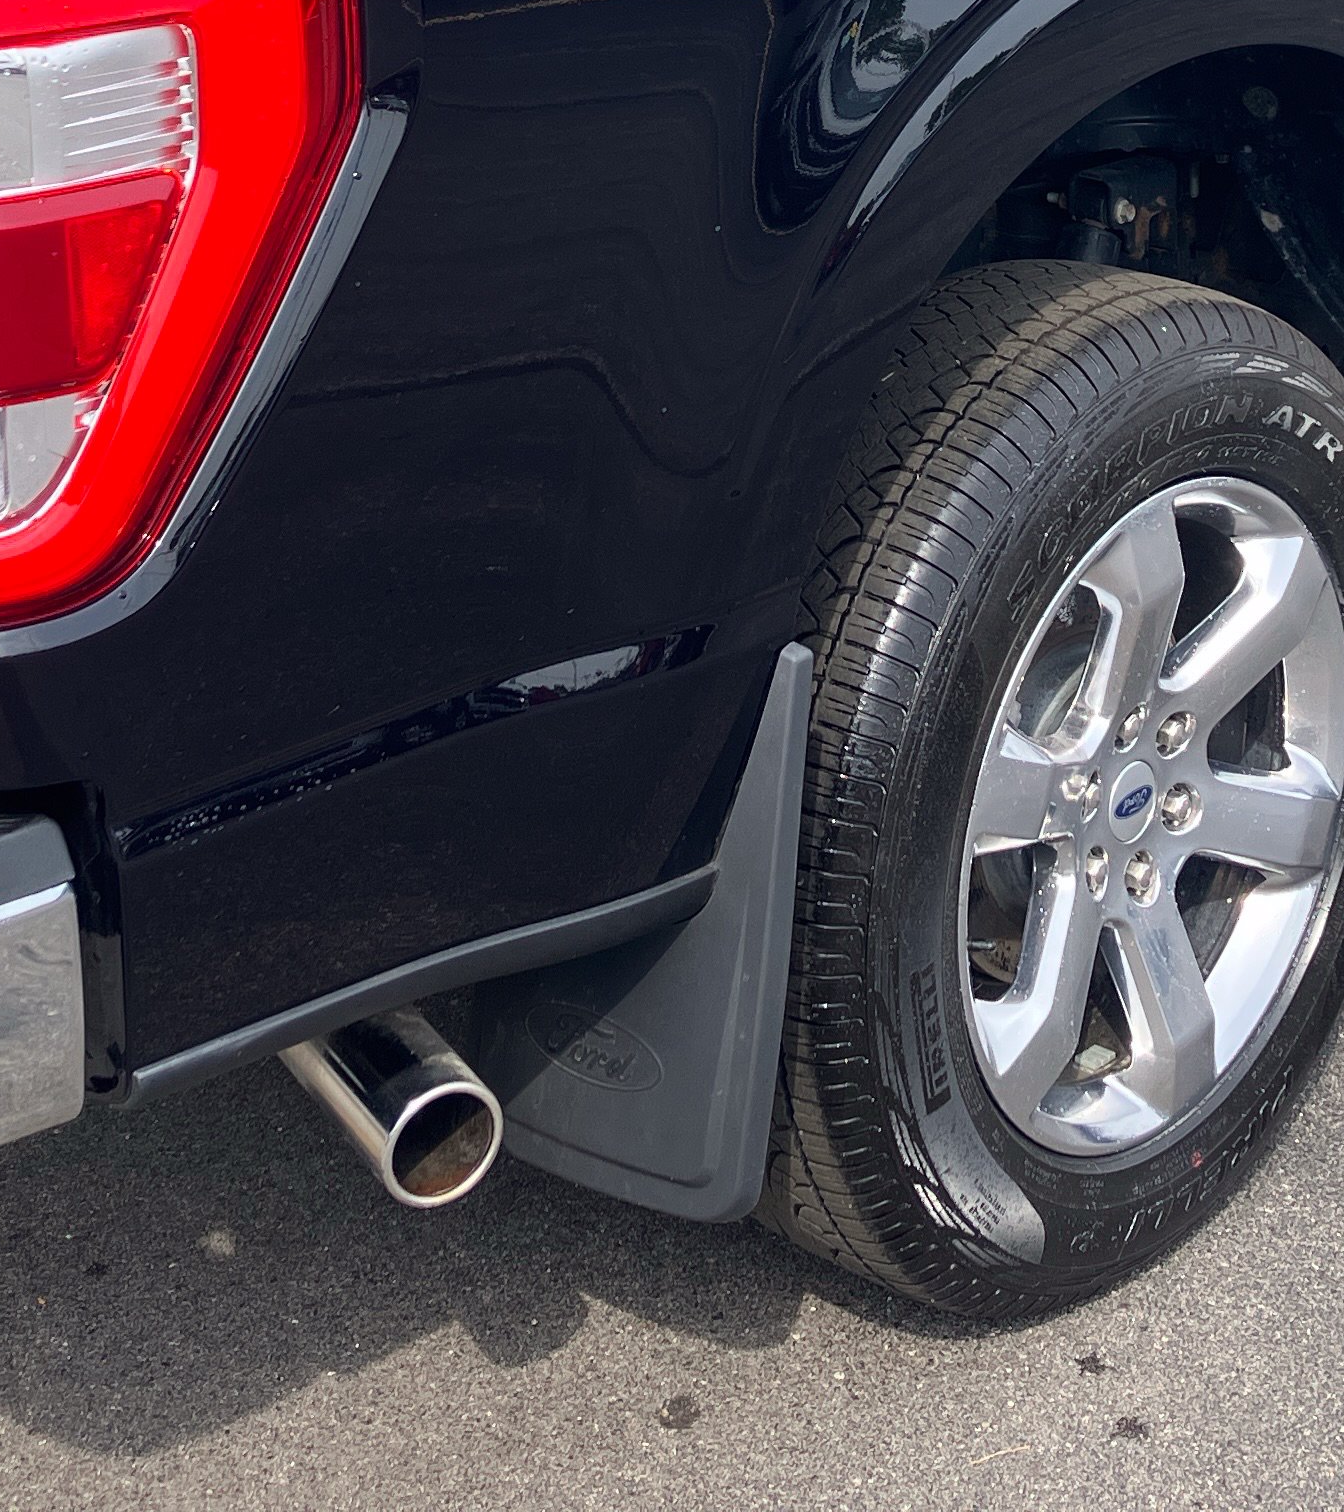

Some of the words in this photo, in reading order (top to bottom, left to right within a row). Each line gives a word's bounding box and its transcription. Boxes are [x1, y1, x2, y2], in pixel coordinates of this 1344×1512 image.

[1005, 391, 1254, 623] SCORPION
[1262, 404, 1344, 465] ATR
[910, 962, 952, 1115] PIRELLI
